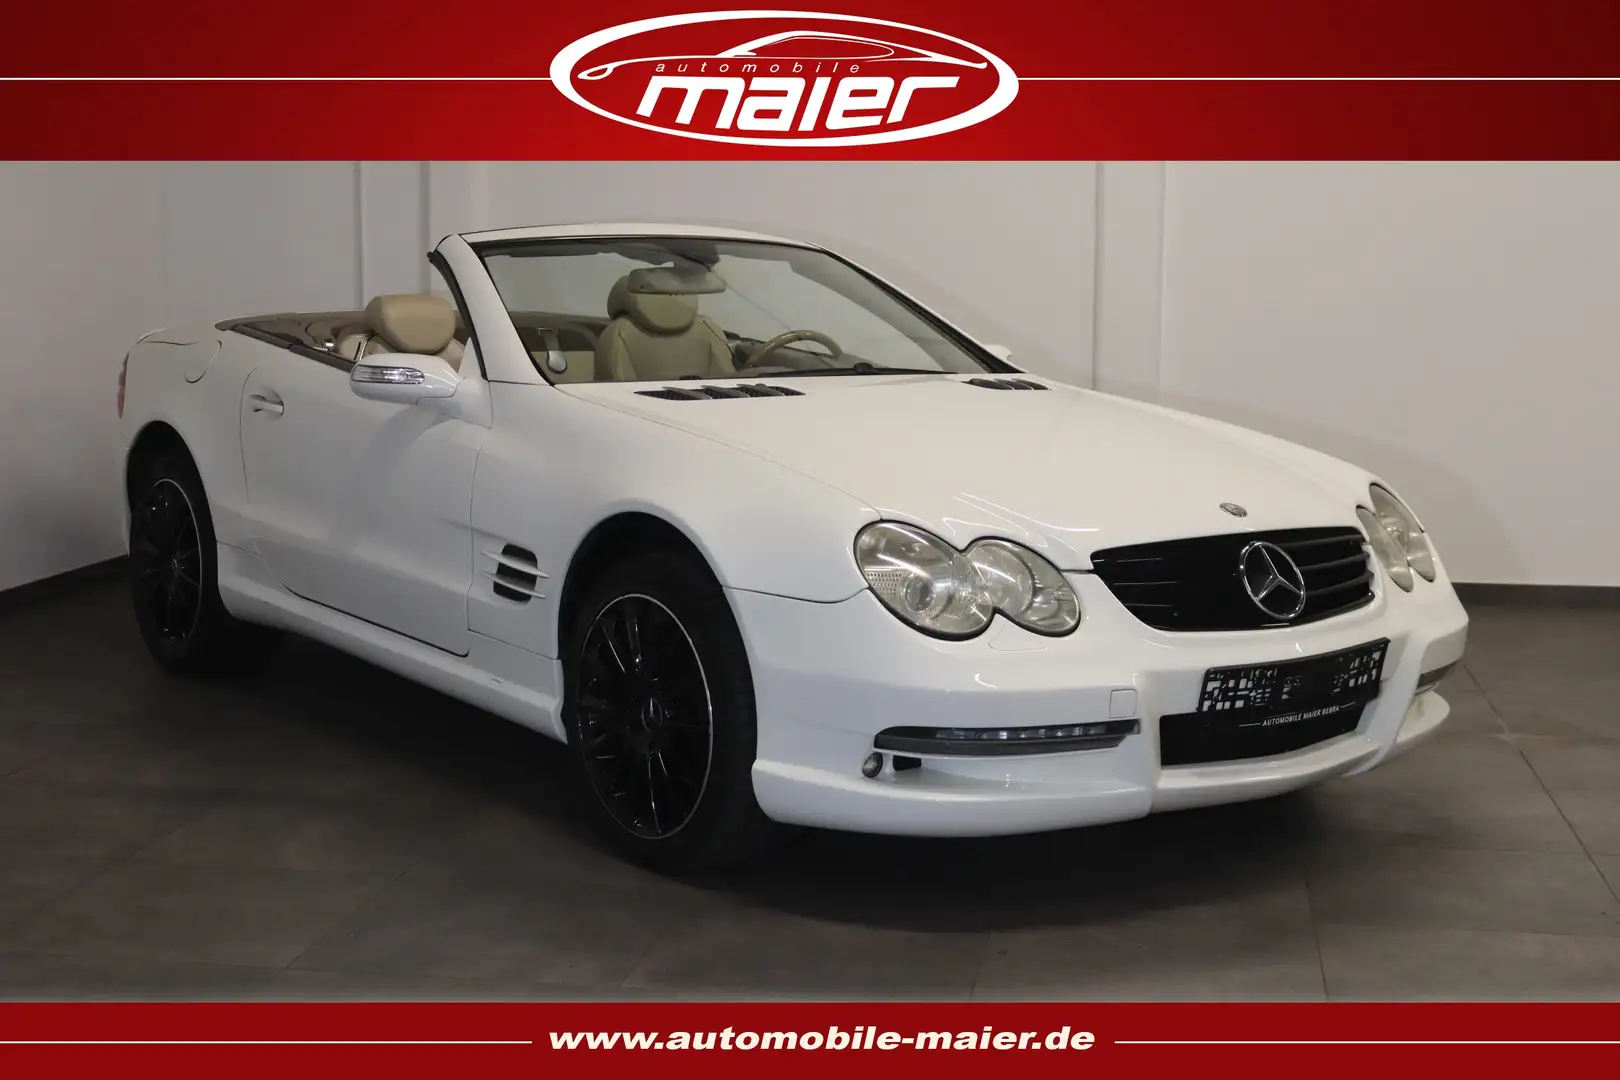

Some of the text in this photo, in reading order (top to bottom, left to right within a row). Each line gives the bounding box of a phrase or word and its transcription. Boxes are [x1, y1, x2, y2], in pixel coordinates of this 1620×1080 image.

[1262, 705, 1340, 727] AUTOMOBILE MAIER BEBRA
